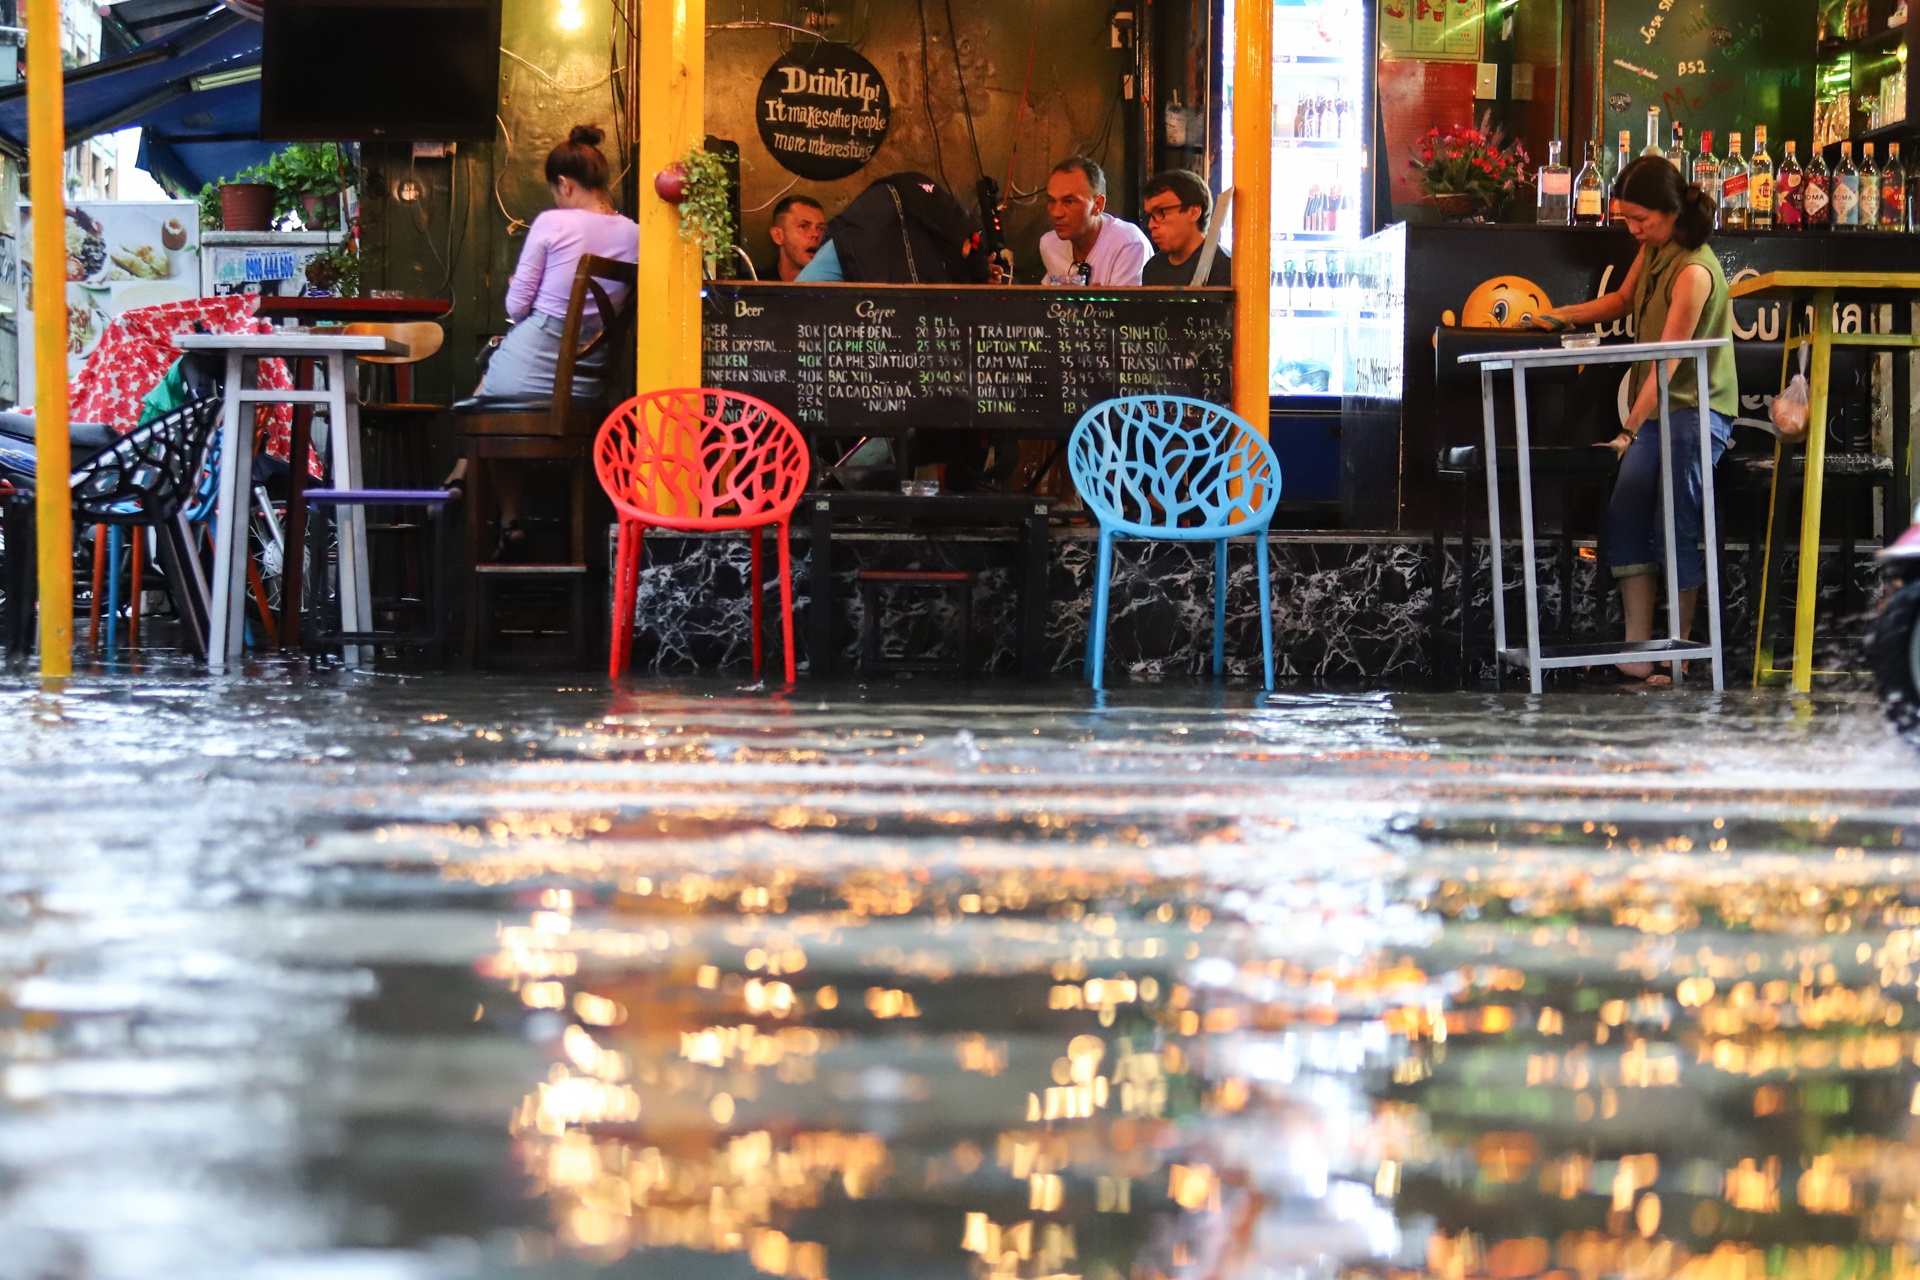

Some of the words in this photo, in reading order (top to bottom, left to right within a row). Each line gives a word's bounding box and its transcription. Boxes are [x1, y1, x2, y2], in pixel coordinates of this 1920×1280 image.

[1640, 14, 1664, 44] Jose
[778, 67, 850, 98] Drink
[849, 72, 880, 112] Up!
[765, 98, 786, 122] It
[851, 108, 886, 137] people
[774, 132, 806, 154] more
[808, 134, 874, 162] interesting
[735, 300, 764, 318] Beer
[1084, 304, 1114, 318] Drink
[798, 324, 820, 338] 30K
[1006, 326, 1044, 338] LIPTON
[732, 340, 778, 352] CRYSTAL
[798, 340, 822, 352] 40K
[918, 340, 930, 353] 25
[977, 340, 1016, 353] LIPTON
[798, 354, 822, 368] 40K
[978, 356, 1003, 368] CAM
[752, 370, 787, 382] SILVER
[798, 370, 824, 382] 40K
[920, 371, 934, 383] 30
[798, 384, 824, 396] 20K
[978, 400, 1016, 413] STING
[798, 409, 824, 422] 40K
